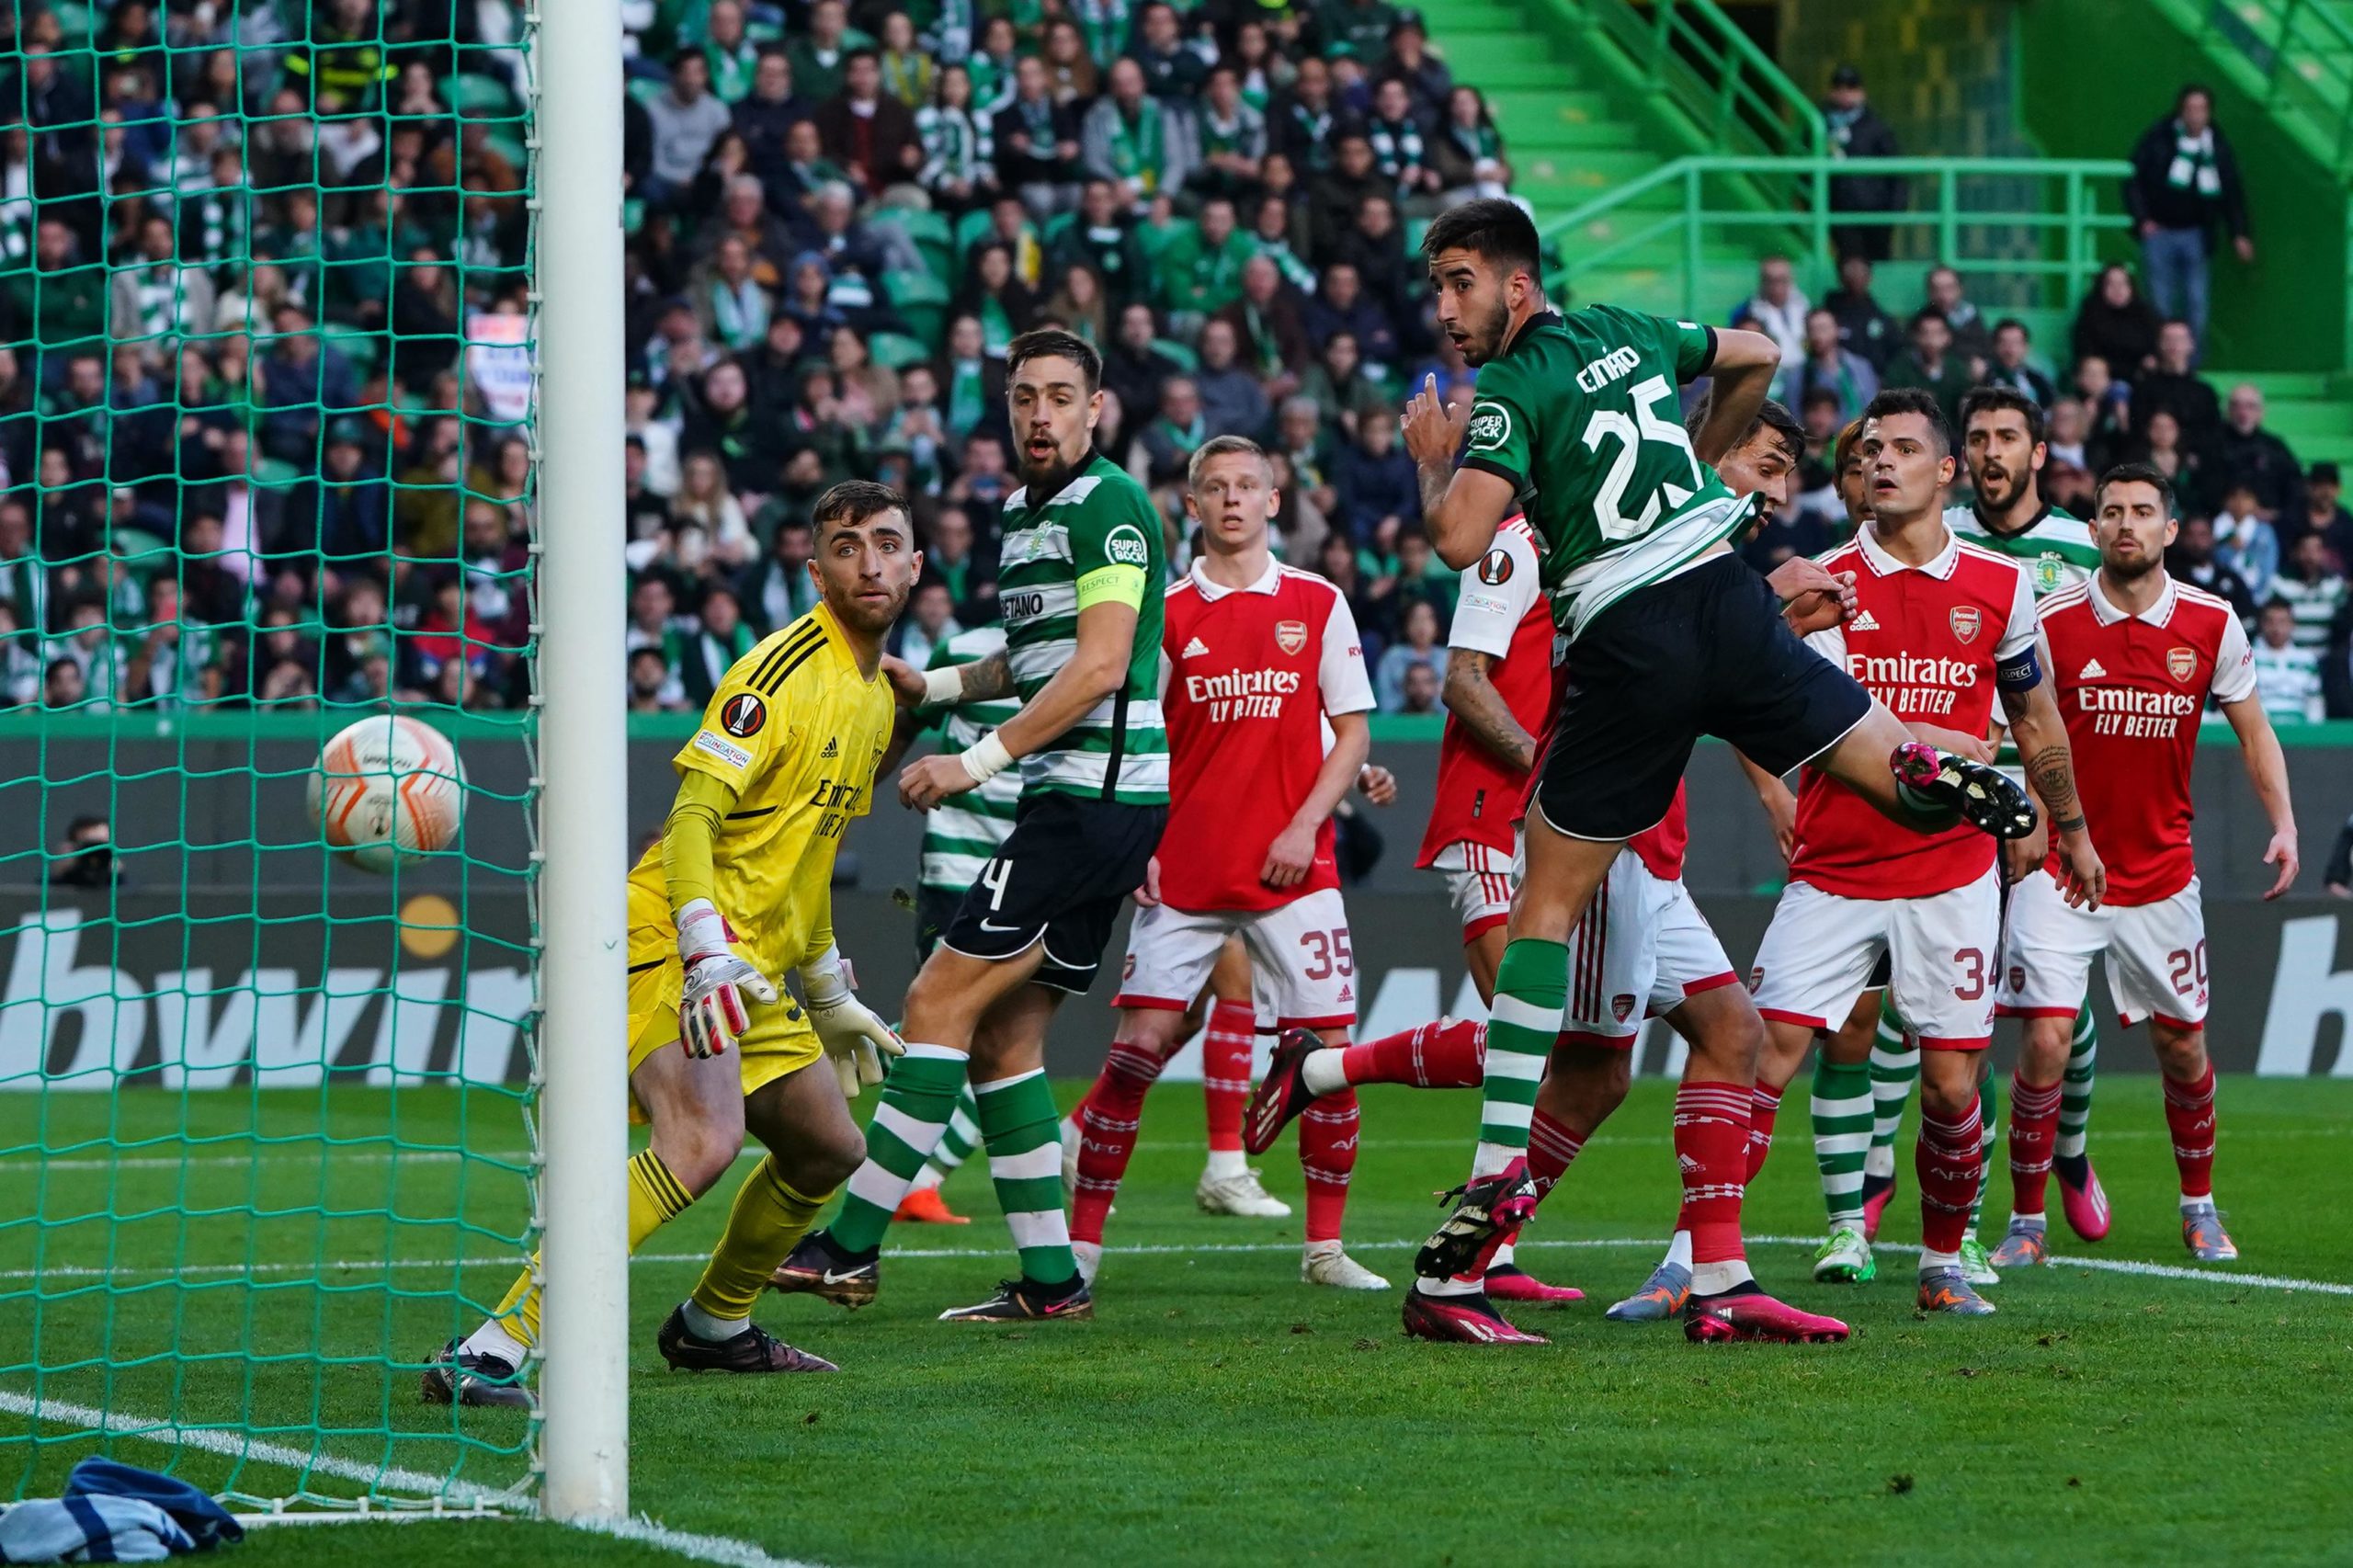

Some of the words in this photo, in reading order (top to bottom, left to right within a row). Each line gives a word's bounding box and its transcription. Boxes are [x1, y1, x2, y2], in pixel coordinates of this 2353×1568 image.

[1469, 426, 1500, 438] CK
[1581, 373, 1705, 542] 25
[1115, 551, 1144, 563] BOCK
[1081, 575, 1120, 593] RESPECT
[1849, 622, 1881, 631] adidas
[1954, 611, 1978, 619] Arsenal
[1846, 650, 1978, 687] Emirates
[1186, 667, 1301, 702] Emirates
[1211, 699, 1231, 722] LY
[1233, 695, 1282, 721] BTTER
[1898, 687, 1956, 714] BETTER
[2078, 687, 2195, 715] Emirates
[2095, 713, 2122, 734] FLY
[2124, 715, 2177, 738] BETTER
[699, 734, 749, 763] FOUNDATION
[983, 858, 1014, 911] 4
[1300, 927, 1353, 981] 35
[2166, 937, 2207, 996] 20
[1930, 1165, 1980, 1181] AFC
